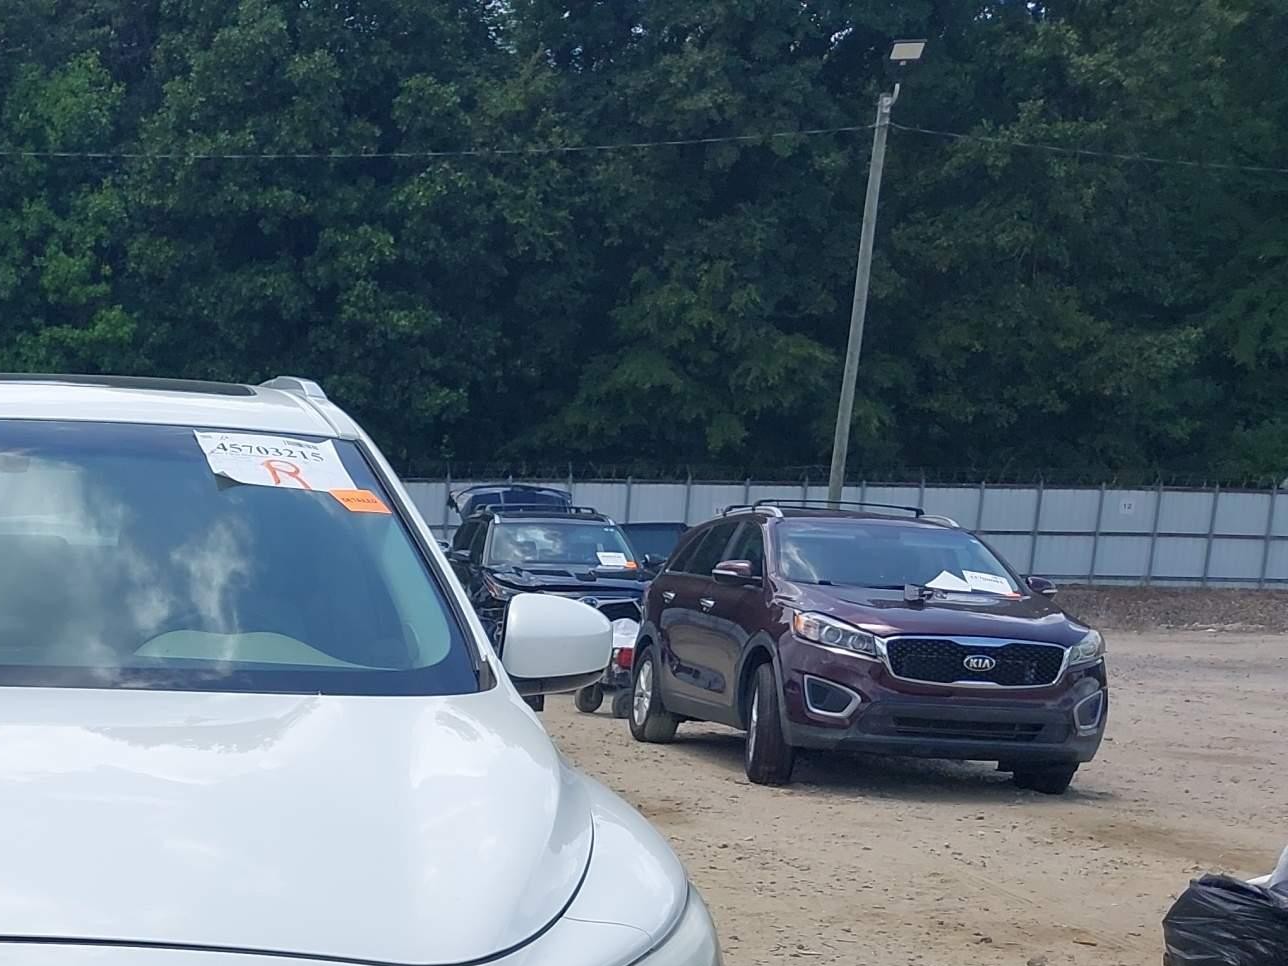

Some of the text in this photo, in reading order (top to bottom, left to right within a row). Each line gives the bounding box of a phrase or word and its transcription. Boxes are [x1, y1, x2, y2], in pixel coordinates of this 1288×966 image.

[215, 441, 325, 463] 45703215
[261, 459, 312, 490] R
[968, 657, 991, 668] KIA
